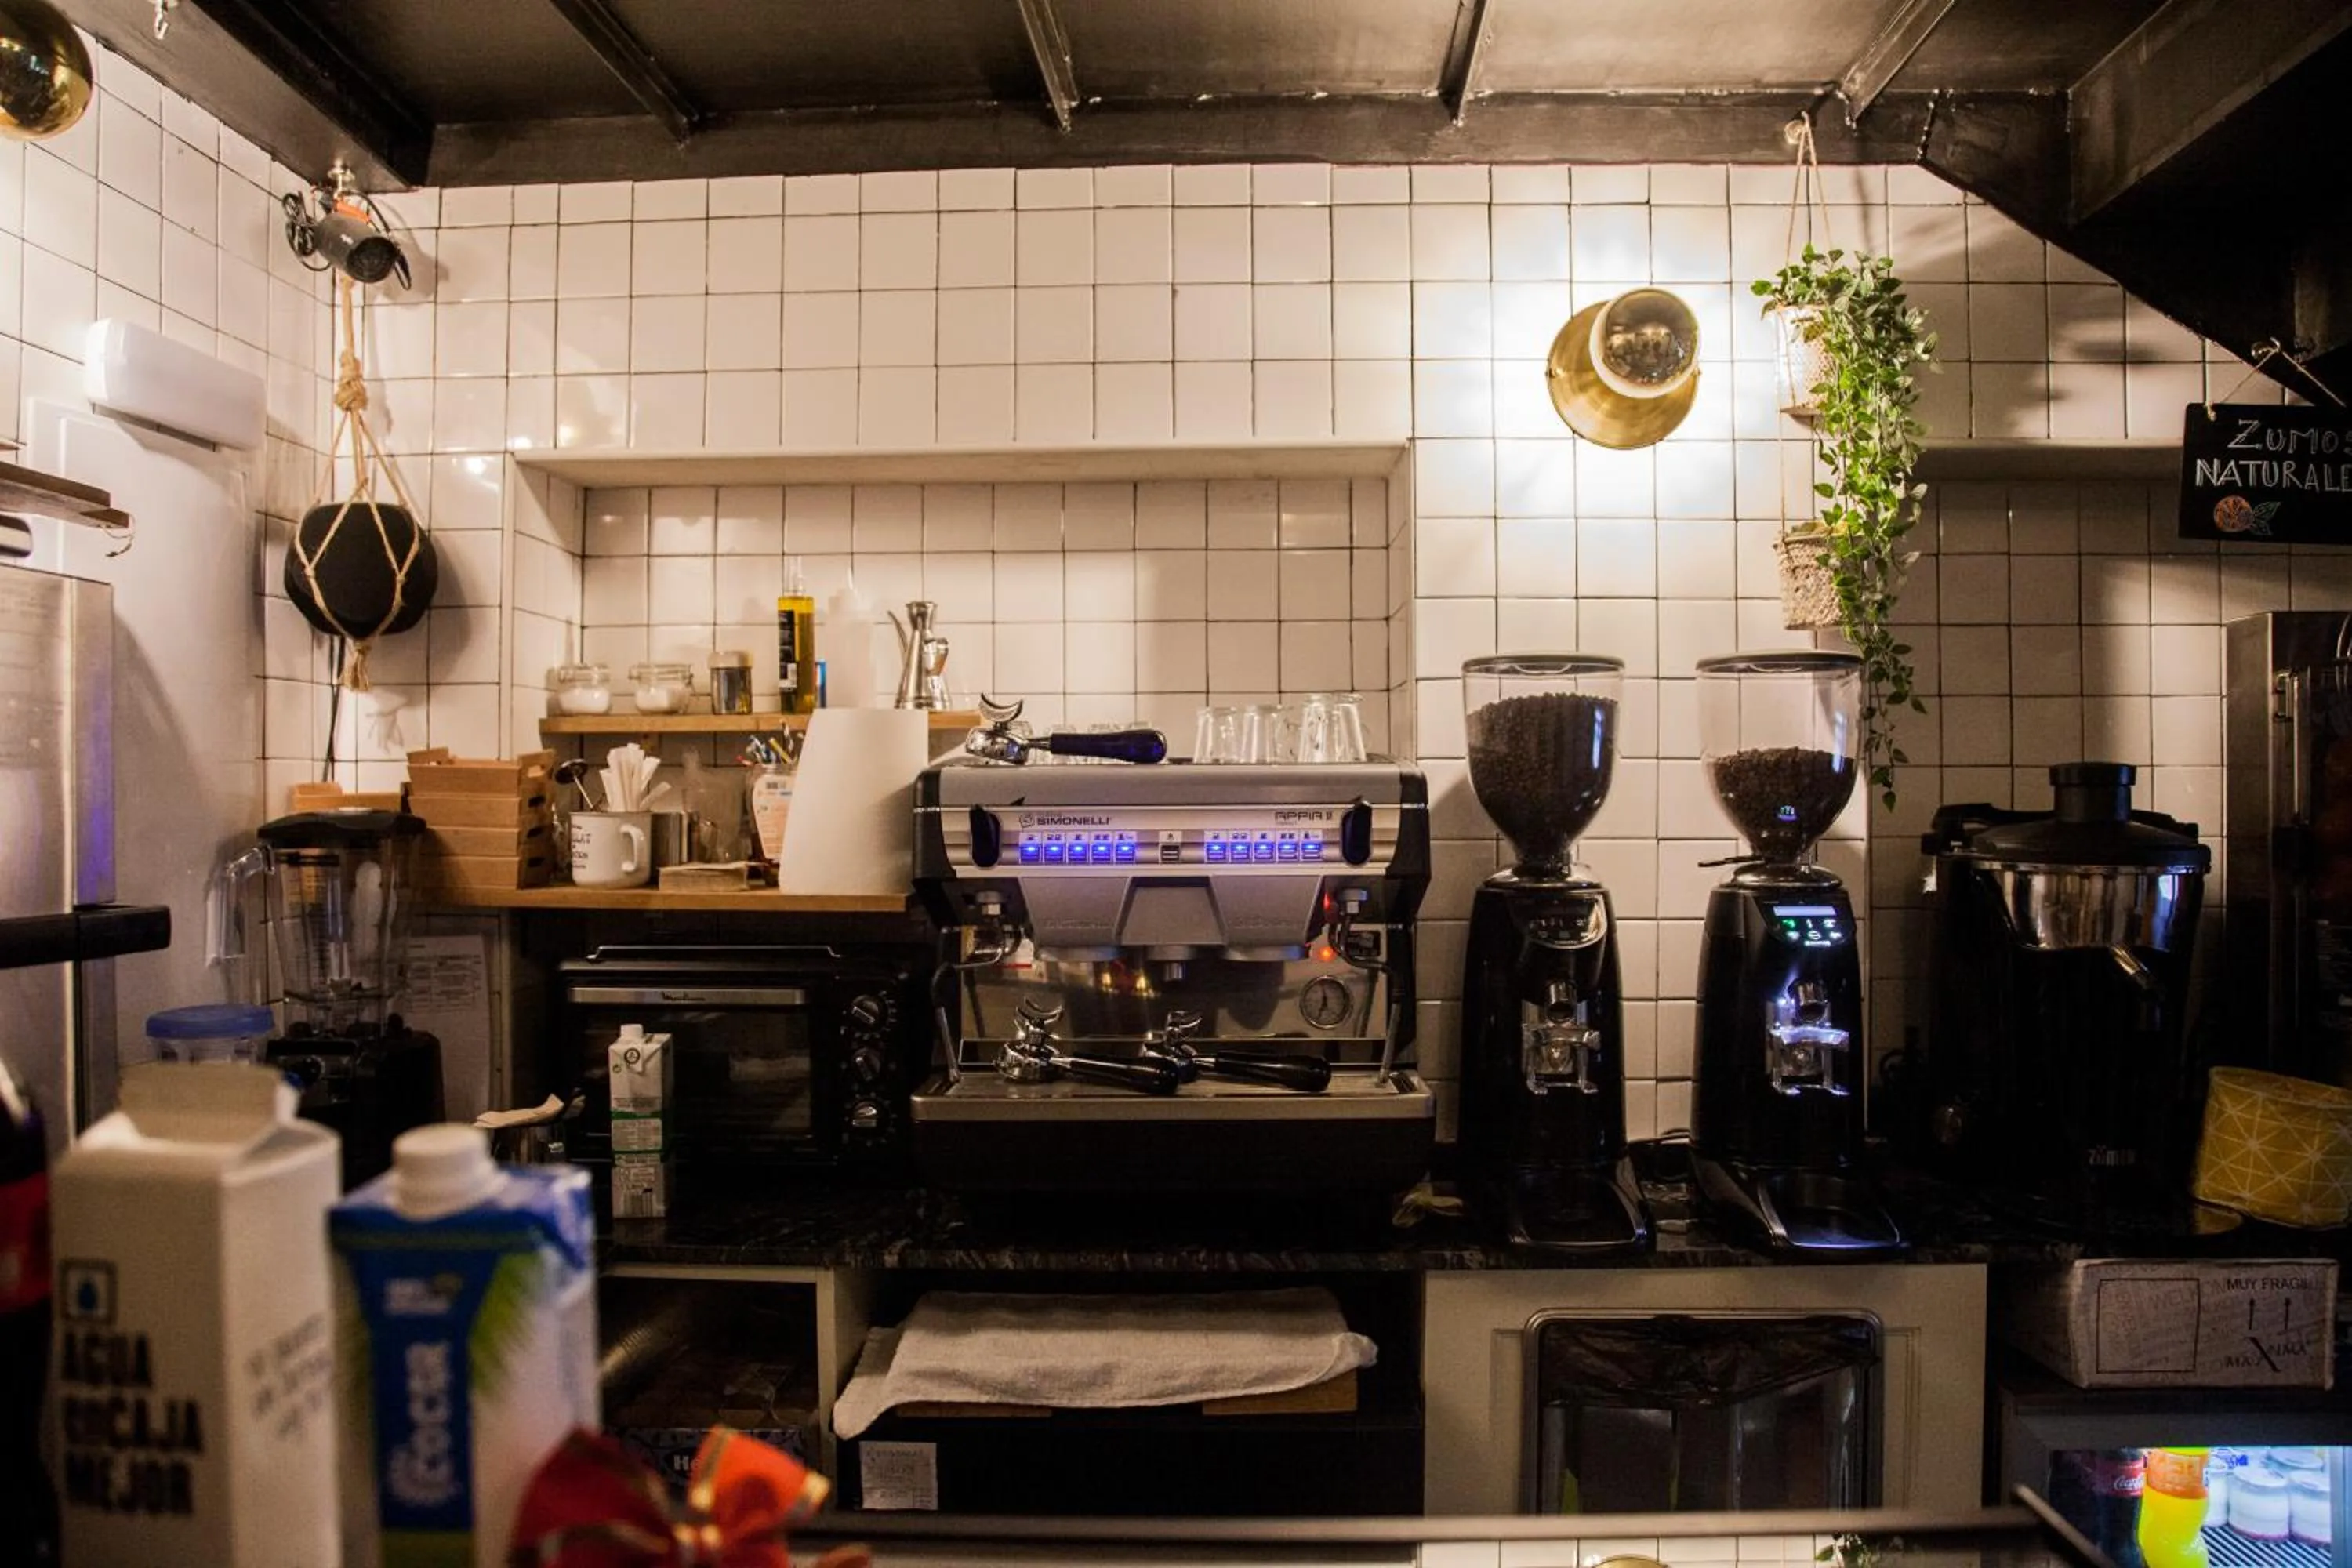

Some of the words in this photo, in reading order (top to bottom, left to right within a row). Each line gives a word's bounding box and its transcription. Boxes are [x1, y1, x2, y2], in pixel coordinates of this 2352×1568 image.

[1036, 816, 1110, 826] SIMONELLI
[1275, 811, 1323, 821] APPIA
[2227, 1278, 2256, 1290] MUY
